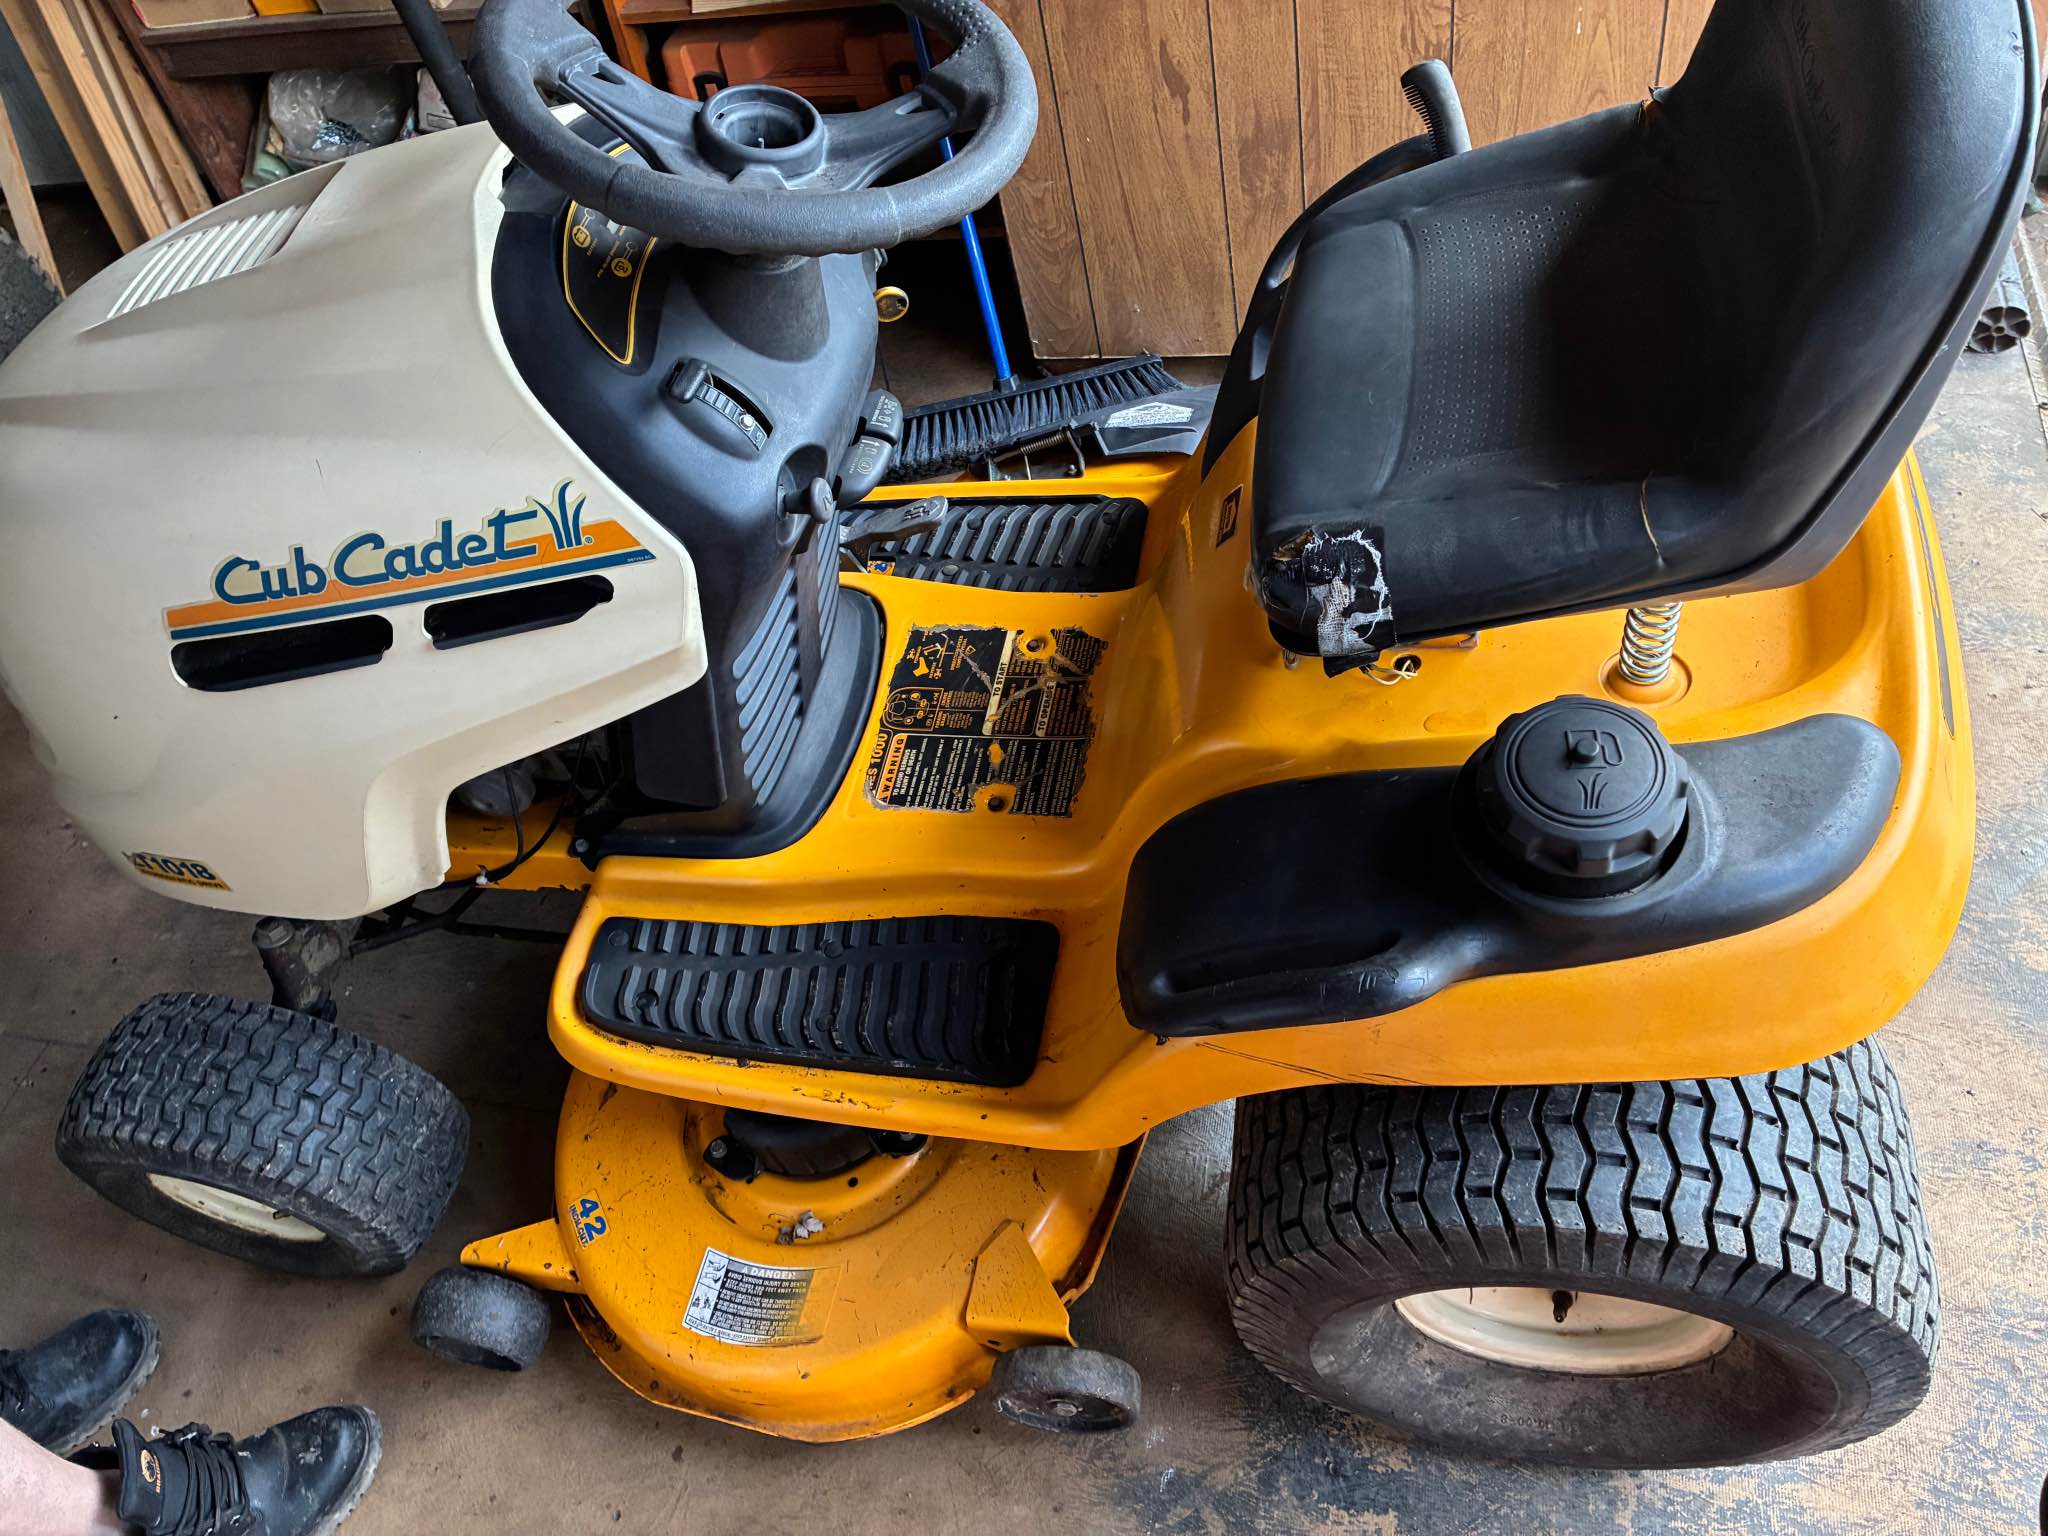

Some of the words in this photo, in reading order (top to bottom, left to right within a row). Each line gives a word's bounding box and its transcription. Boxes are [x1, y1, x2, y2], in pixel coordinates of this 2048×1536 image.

[214, 546, 327, 604] Cub
[333, 508, 538, 585] Cadet
[996, 662, 1008, 685] START
[993, 686, 1001, 697] TO
[1038, 720, 1046, 731] TO
[882, 738, 905, 792] WARNING
[580, 1199, 606, 1241] 42
[751, 1267, 797, 1280] DANGER
